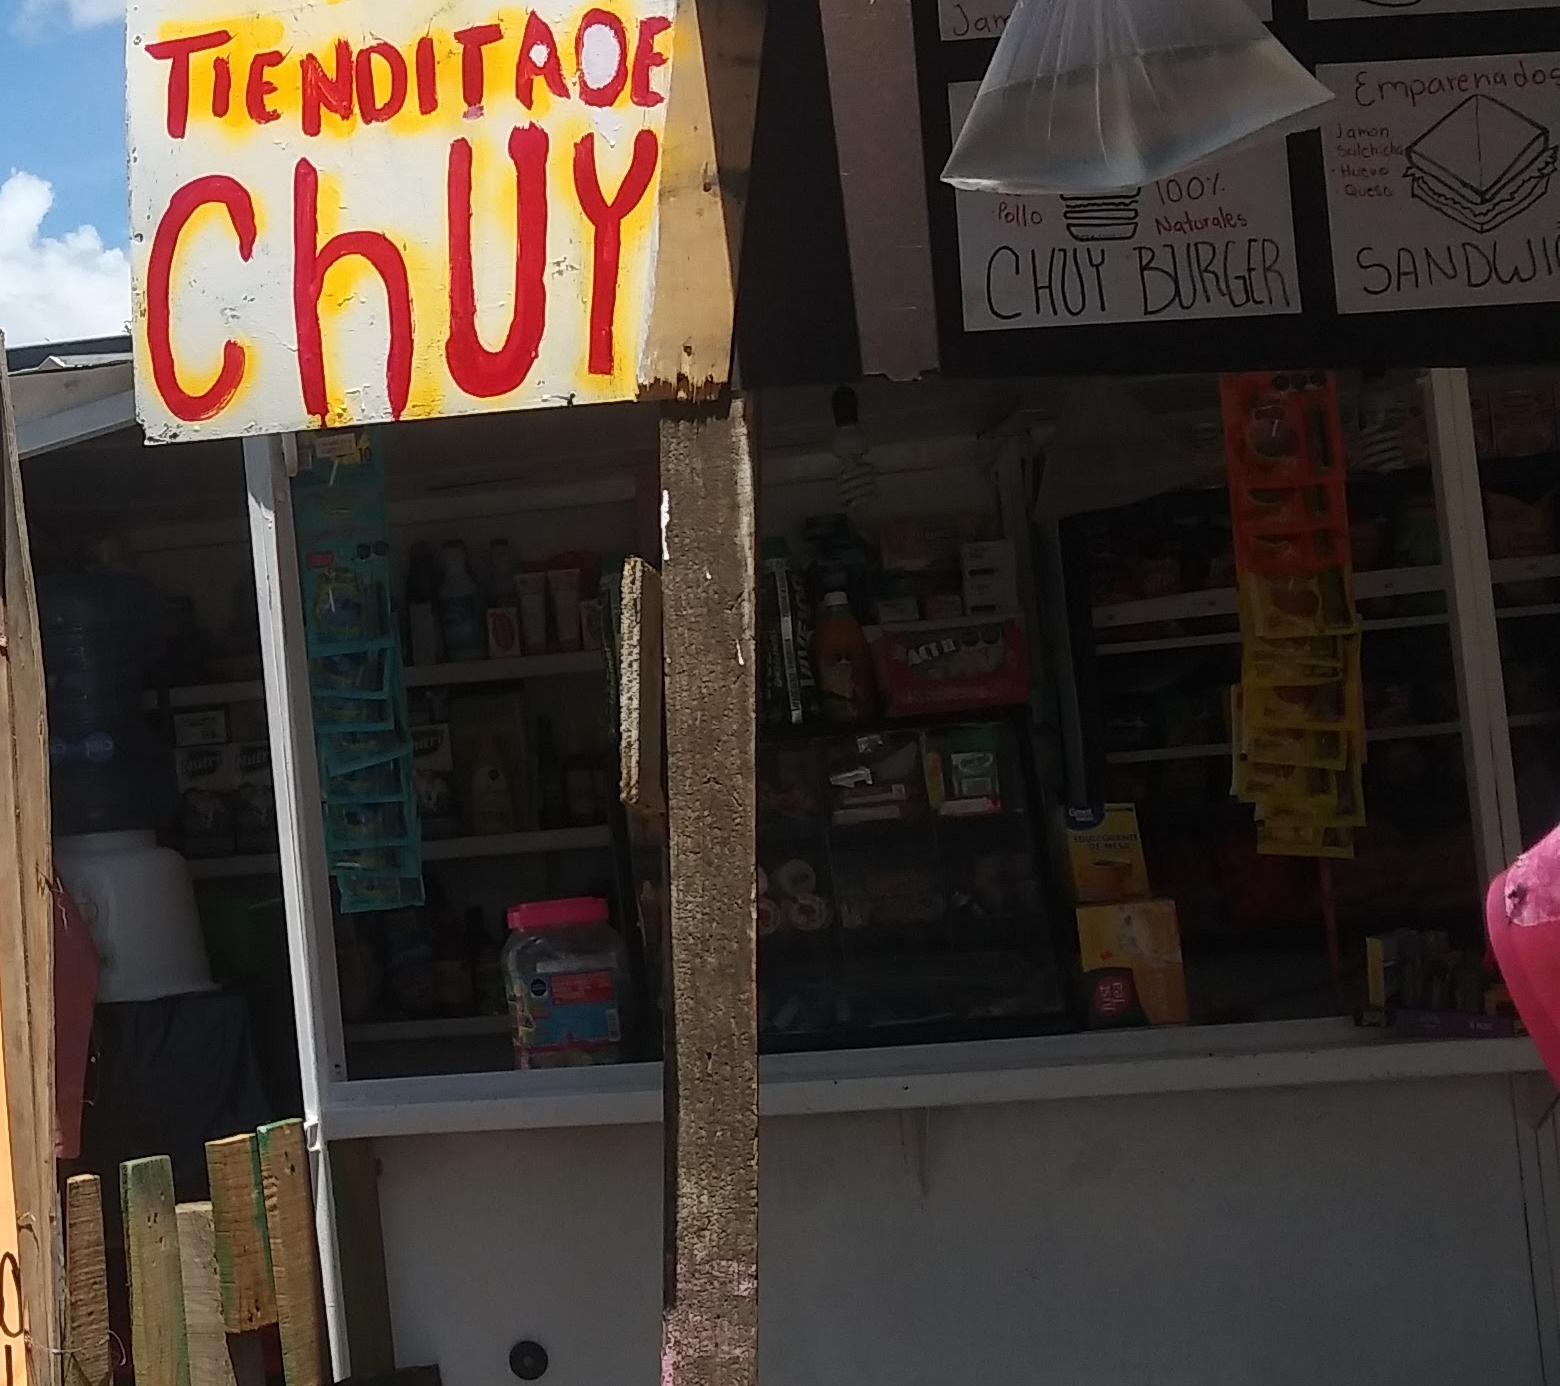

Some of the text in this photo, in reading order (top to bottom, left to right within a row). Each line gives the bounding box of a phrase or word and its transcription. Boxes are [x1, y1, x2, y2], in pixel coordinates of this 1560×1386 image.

[144, 9, 572, 139] TIENDITA
[1156, 172, 1226, 206] 100%
[1155, 206, 1248, 235] Naturales
[986, 238, 1290, 320] CHUY BURGER
